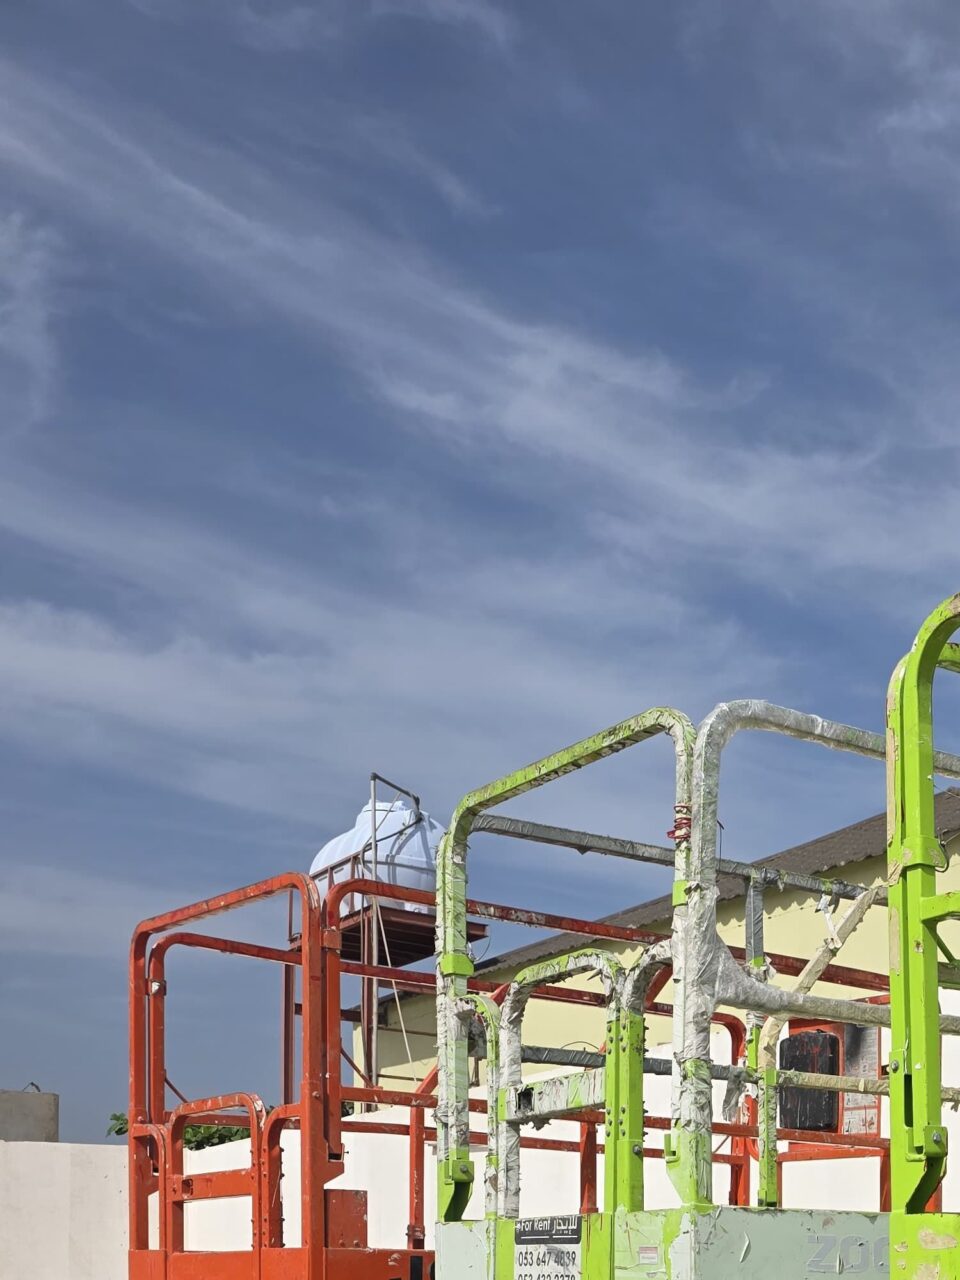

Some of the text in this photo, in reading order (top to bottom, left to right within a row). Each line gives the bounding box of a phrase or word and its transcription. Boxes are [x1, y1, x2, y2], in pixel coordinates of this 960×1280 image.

[520, 1217, 550, 1231] For Rent
[518, 1251, 534, 1267] 053
[536, 1251, 552, 1267] 647
